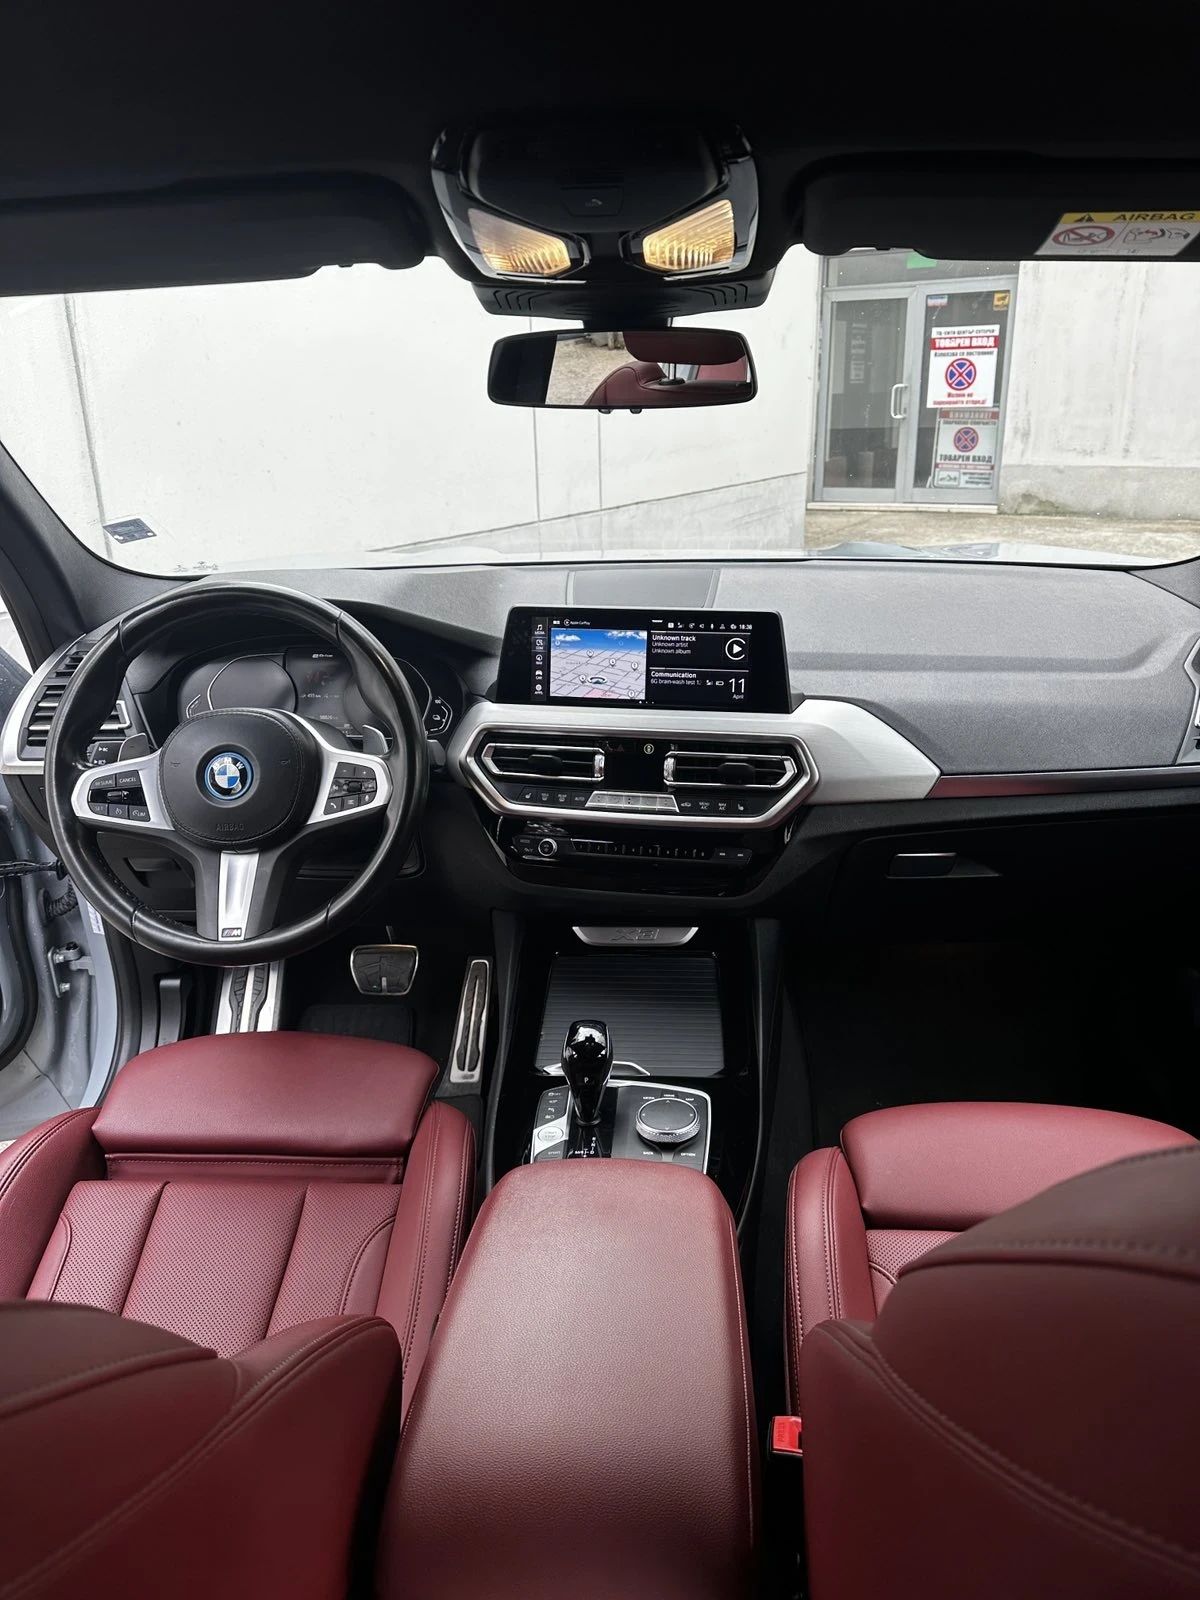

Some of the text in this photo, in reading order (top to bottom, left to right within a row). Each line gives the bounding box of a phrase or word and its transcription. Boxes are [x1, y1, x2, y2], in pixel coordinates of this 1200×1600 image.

[1112, 213, 1196, 222] AIRBAG
[935, 337, 995, 348] ТОВАРЕН ВХОД
[939, 454, 993, 463] ТОВАРЕН ВХОД
[729, 678, 745, 693] 11
[212, 757, 245, 770] BMW
[216, 823, 245, 832] AIRBAG
[612, 928, 660, 941] X3
